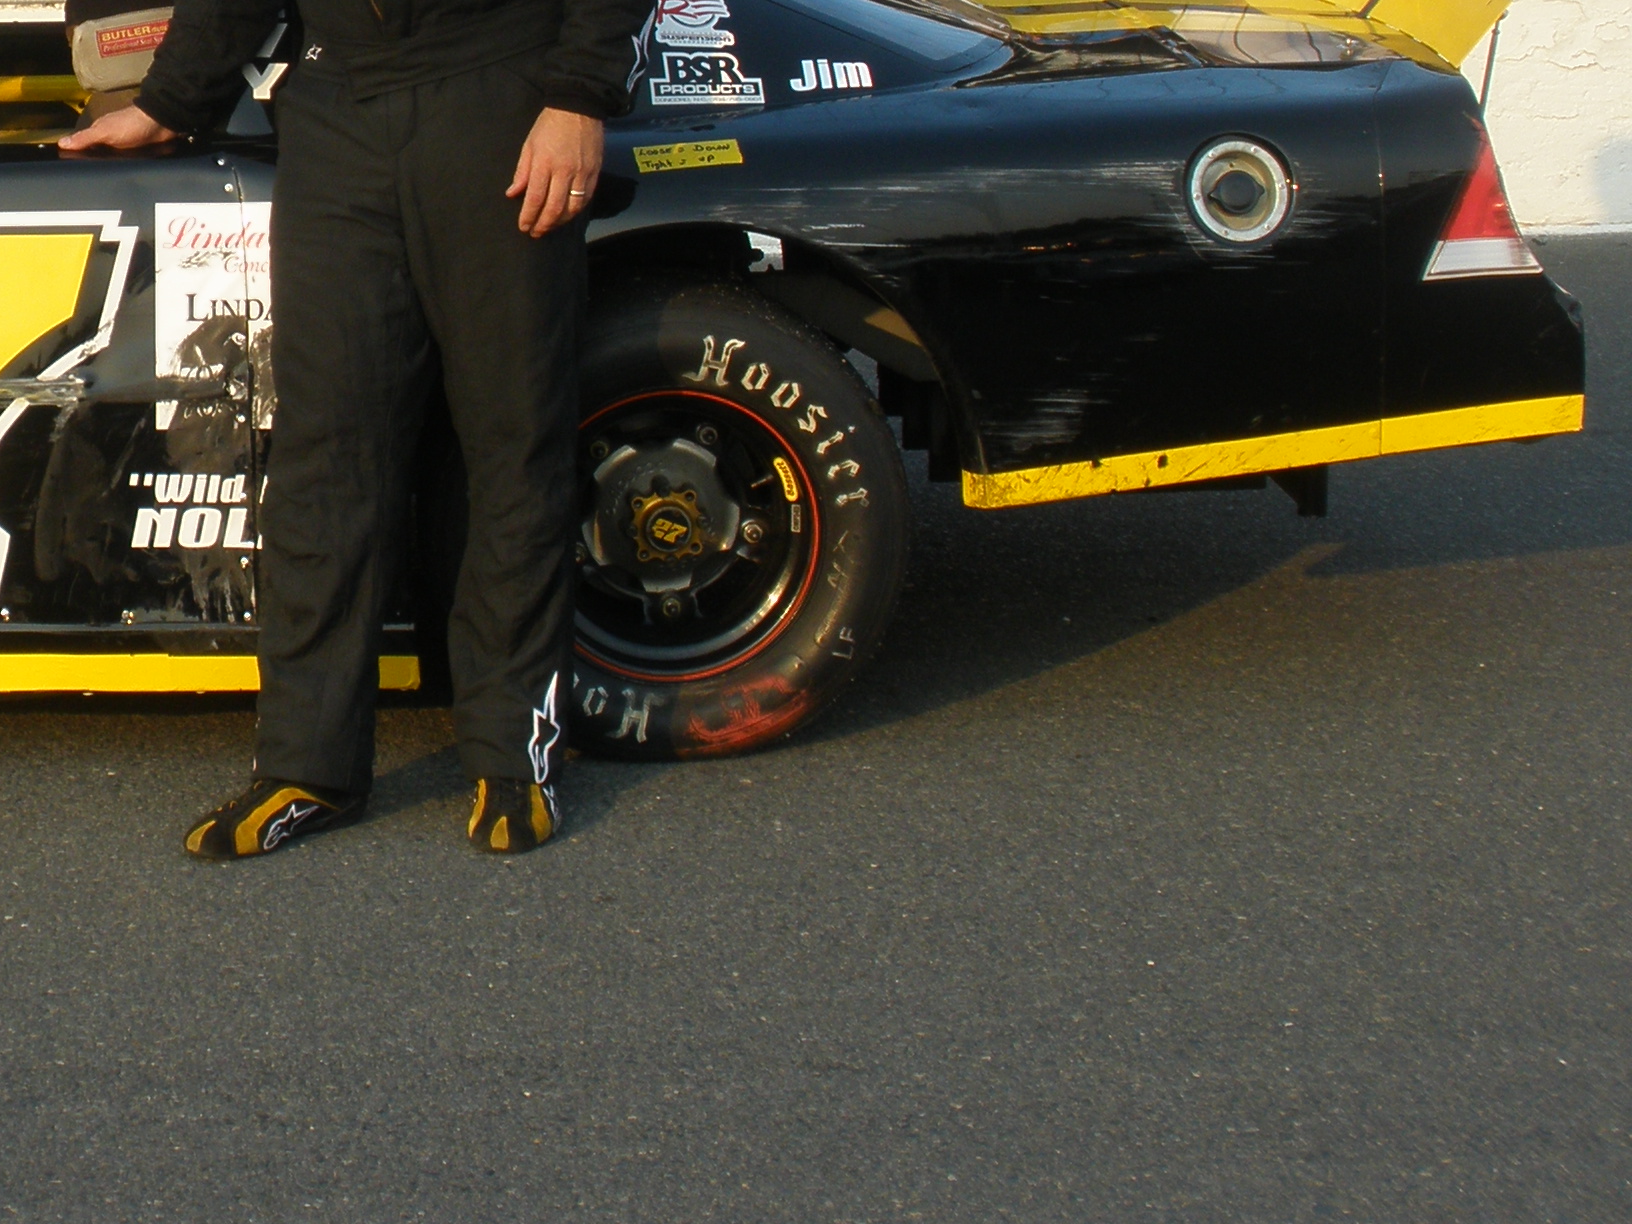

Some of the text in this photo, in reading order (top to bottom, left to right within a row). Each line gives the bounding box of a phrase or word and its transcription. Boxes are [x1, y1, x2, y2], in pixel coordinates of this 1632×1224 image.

[101, 25, 151, 43] BUTLER
[666, 56, 743, 83] BSR
[789, 59, 873, 92] Jim
[659, 84, 756, 94] PRODUCTS
[162, 215, 268, 250] Linda
[223, 255, 269, 275] Conc
[683, 334, 870, 507] Hoosier
[131, 508, 262, 549] NOL
